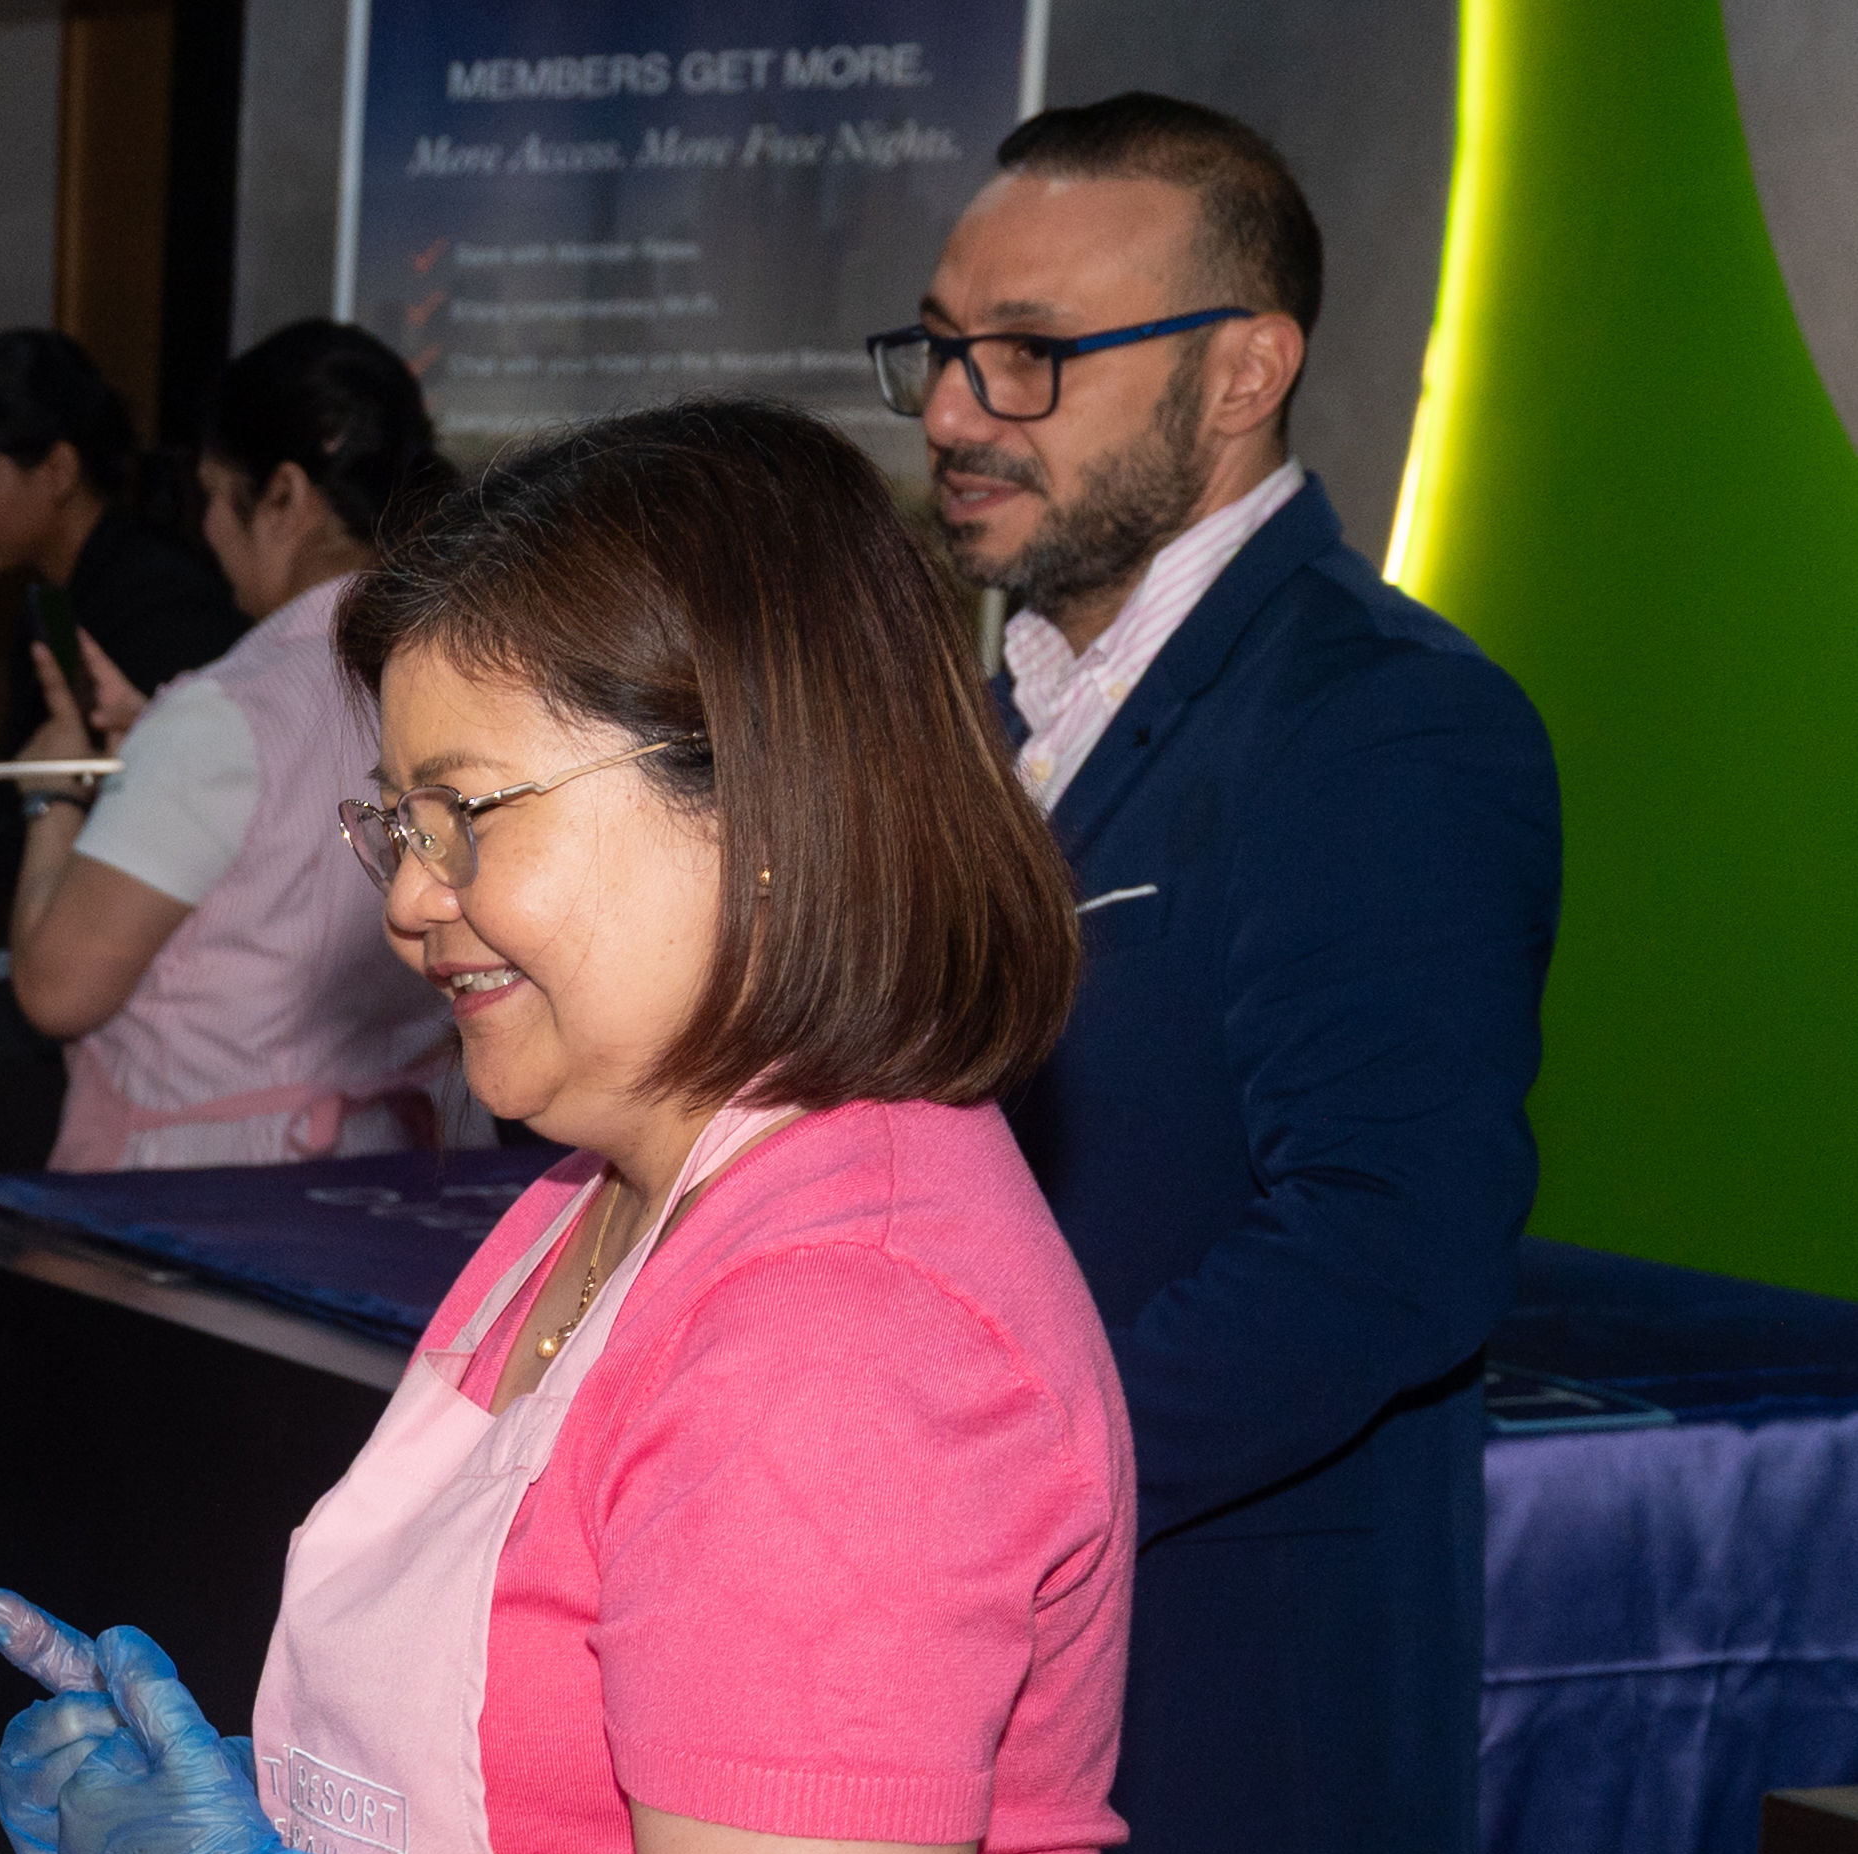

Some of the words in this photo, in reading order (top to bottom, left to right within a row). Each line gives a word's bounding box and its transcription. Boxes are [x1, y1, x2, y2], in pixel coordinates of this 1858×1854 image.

[449, 54, 669, 100] MEMBERS
[682, 49, 775, 92] GET
[785, 44, 931, 87] MORE.
[407, 135, 501, 176] More
[635, 126, 734, 166] More
[741, 125, 824, 165] Free
[296, 1764, 398, 1839] RESORT
